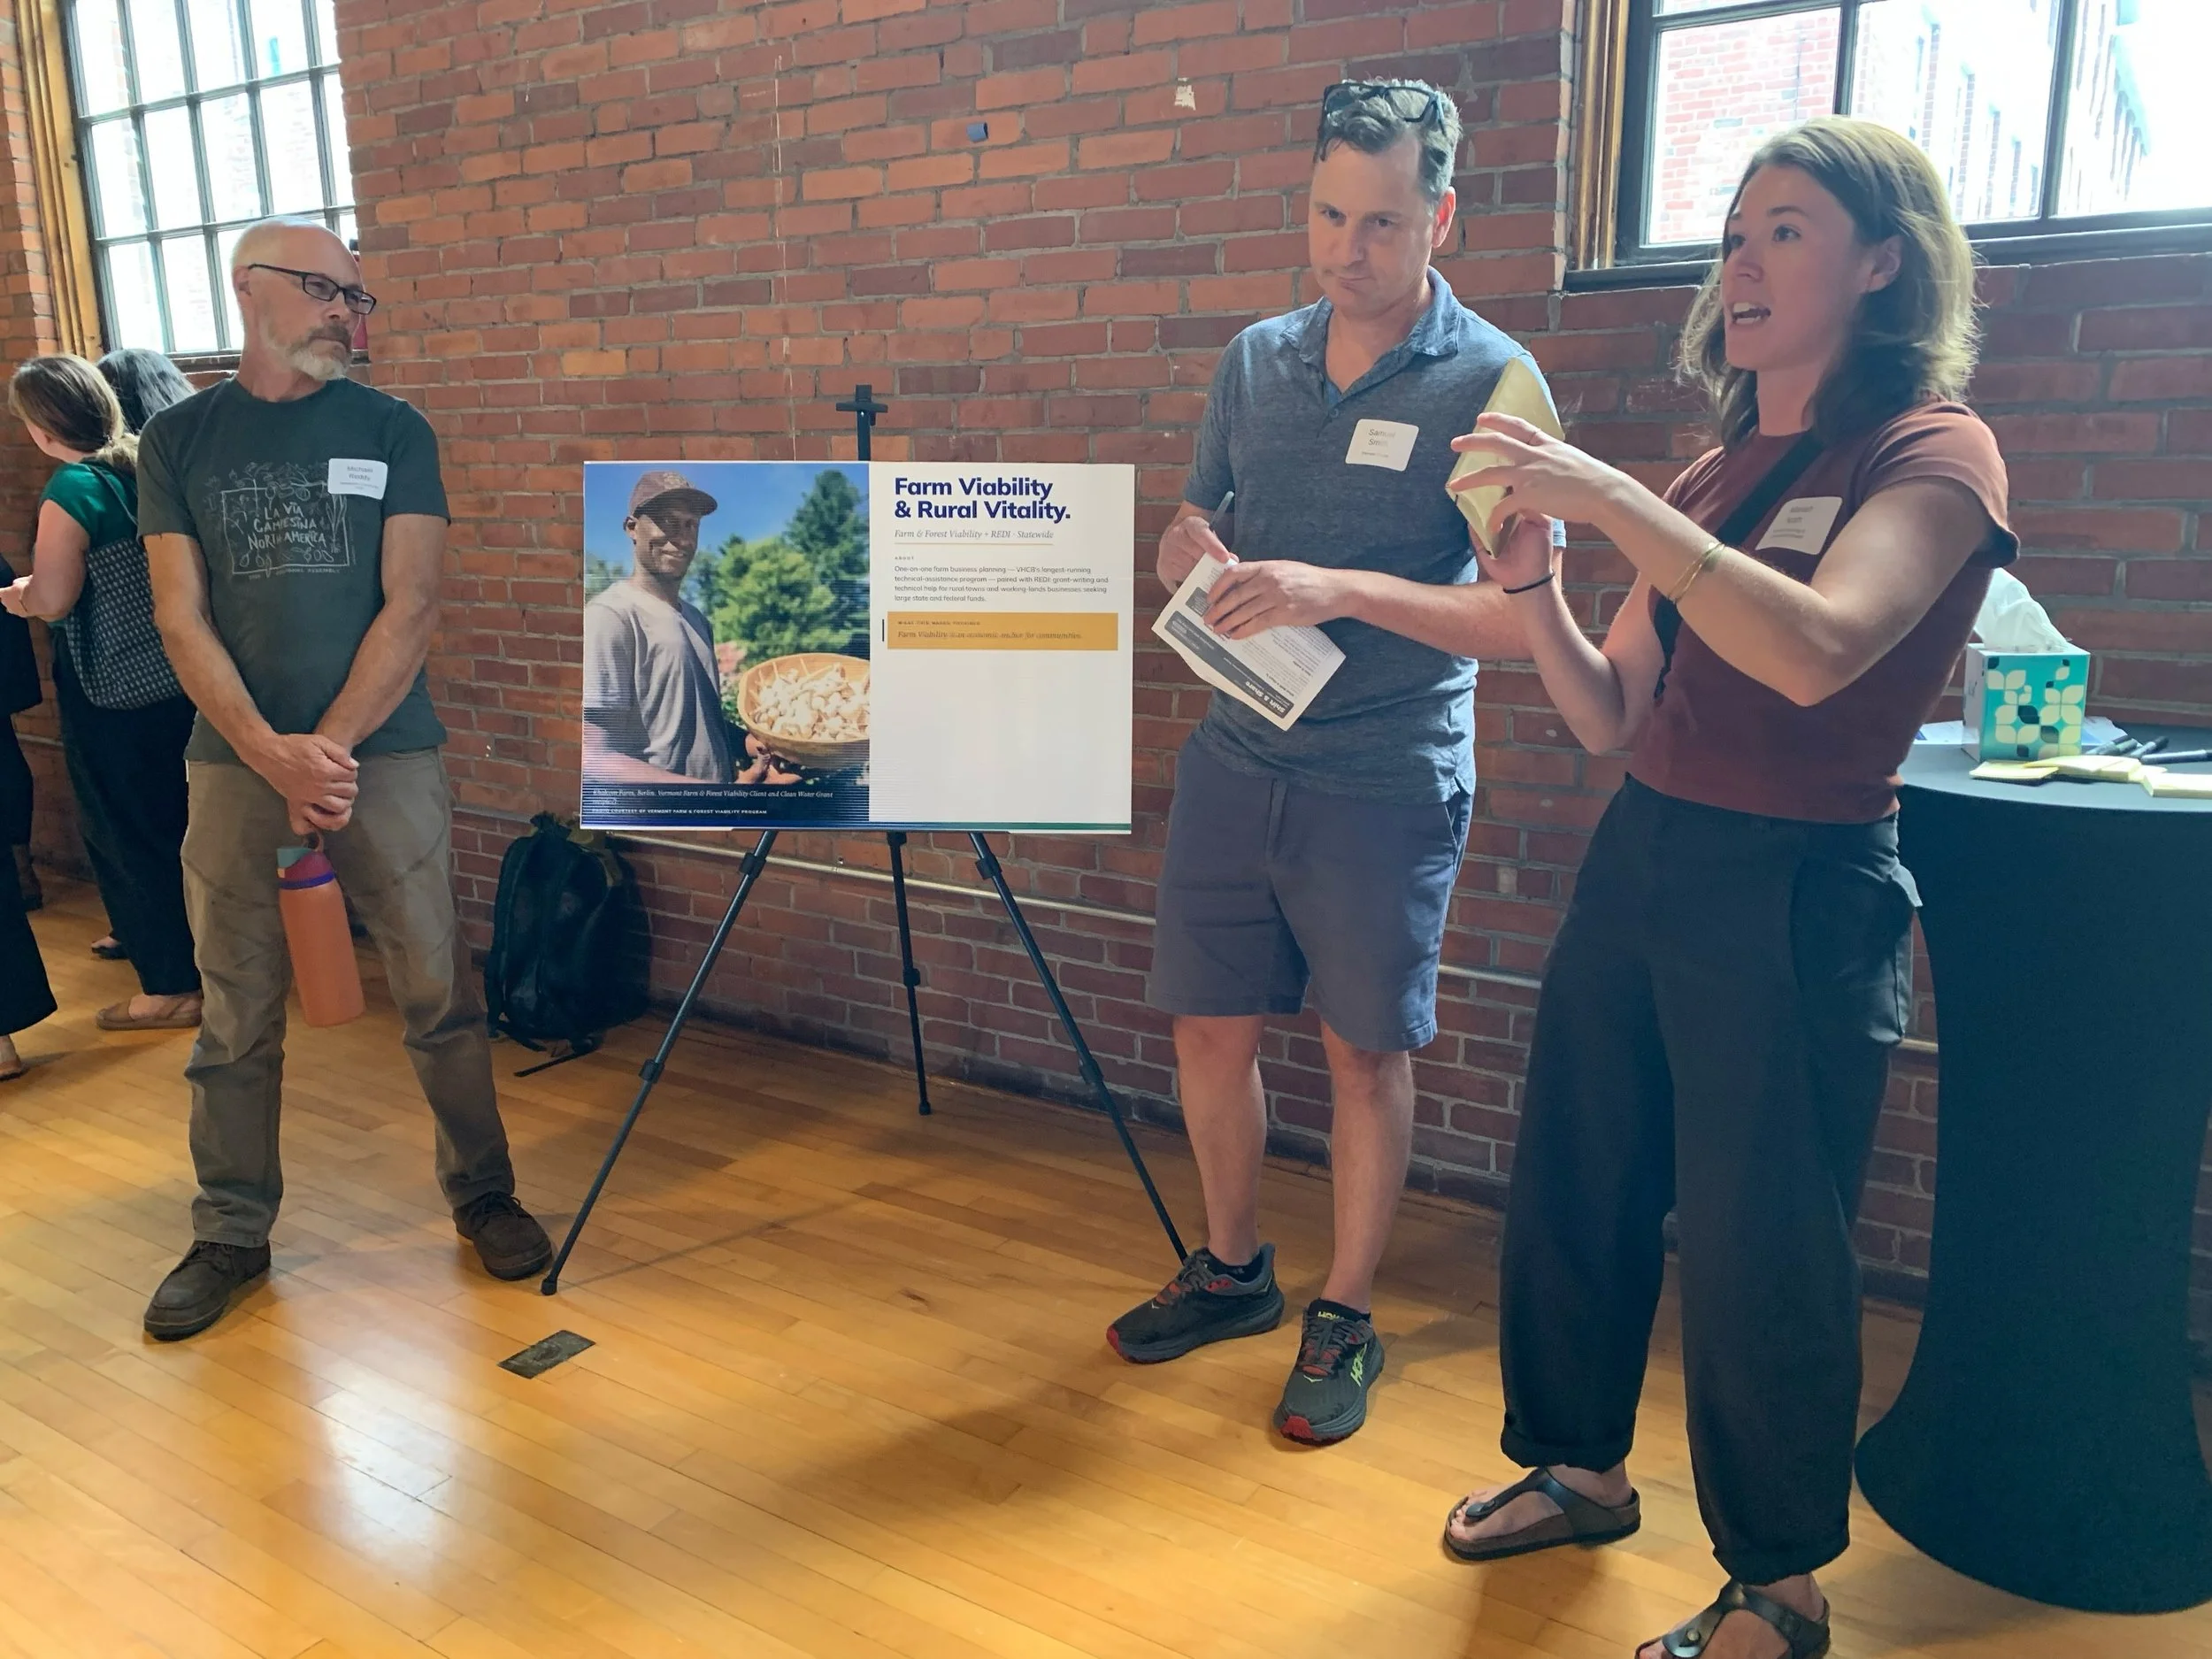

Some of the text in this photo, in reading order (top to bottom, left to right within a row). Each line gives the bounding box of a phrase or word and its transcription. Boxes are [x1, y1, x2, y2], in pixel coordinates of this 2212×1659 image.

[895, 477, 1054, 501] Farm Viability
[265, 506, 280, 520] LA
[895, 500, 1071, 524] & Rural Vitality.
[284, 530, 327, 549] AMERICA
[895, 529, 915, 538] Farm
[925, 529, 948, 538] Forest
[949, 529, 982, 540] Viability
[1018, 530, 1055, 539] Statewide
[1317, 1310, 1344, 1320] HOK
